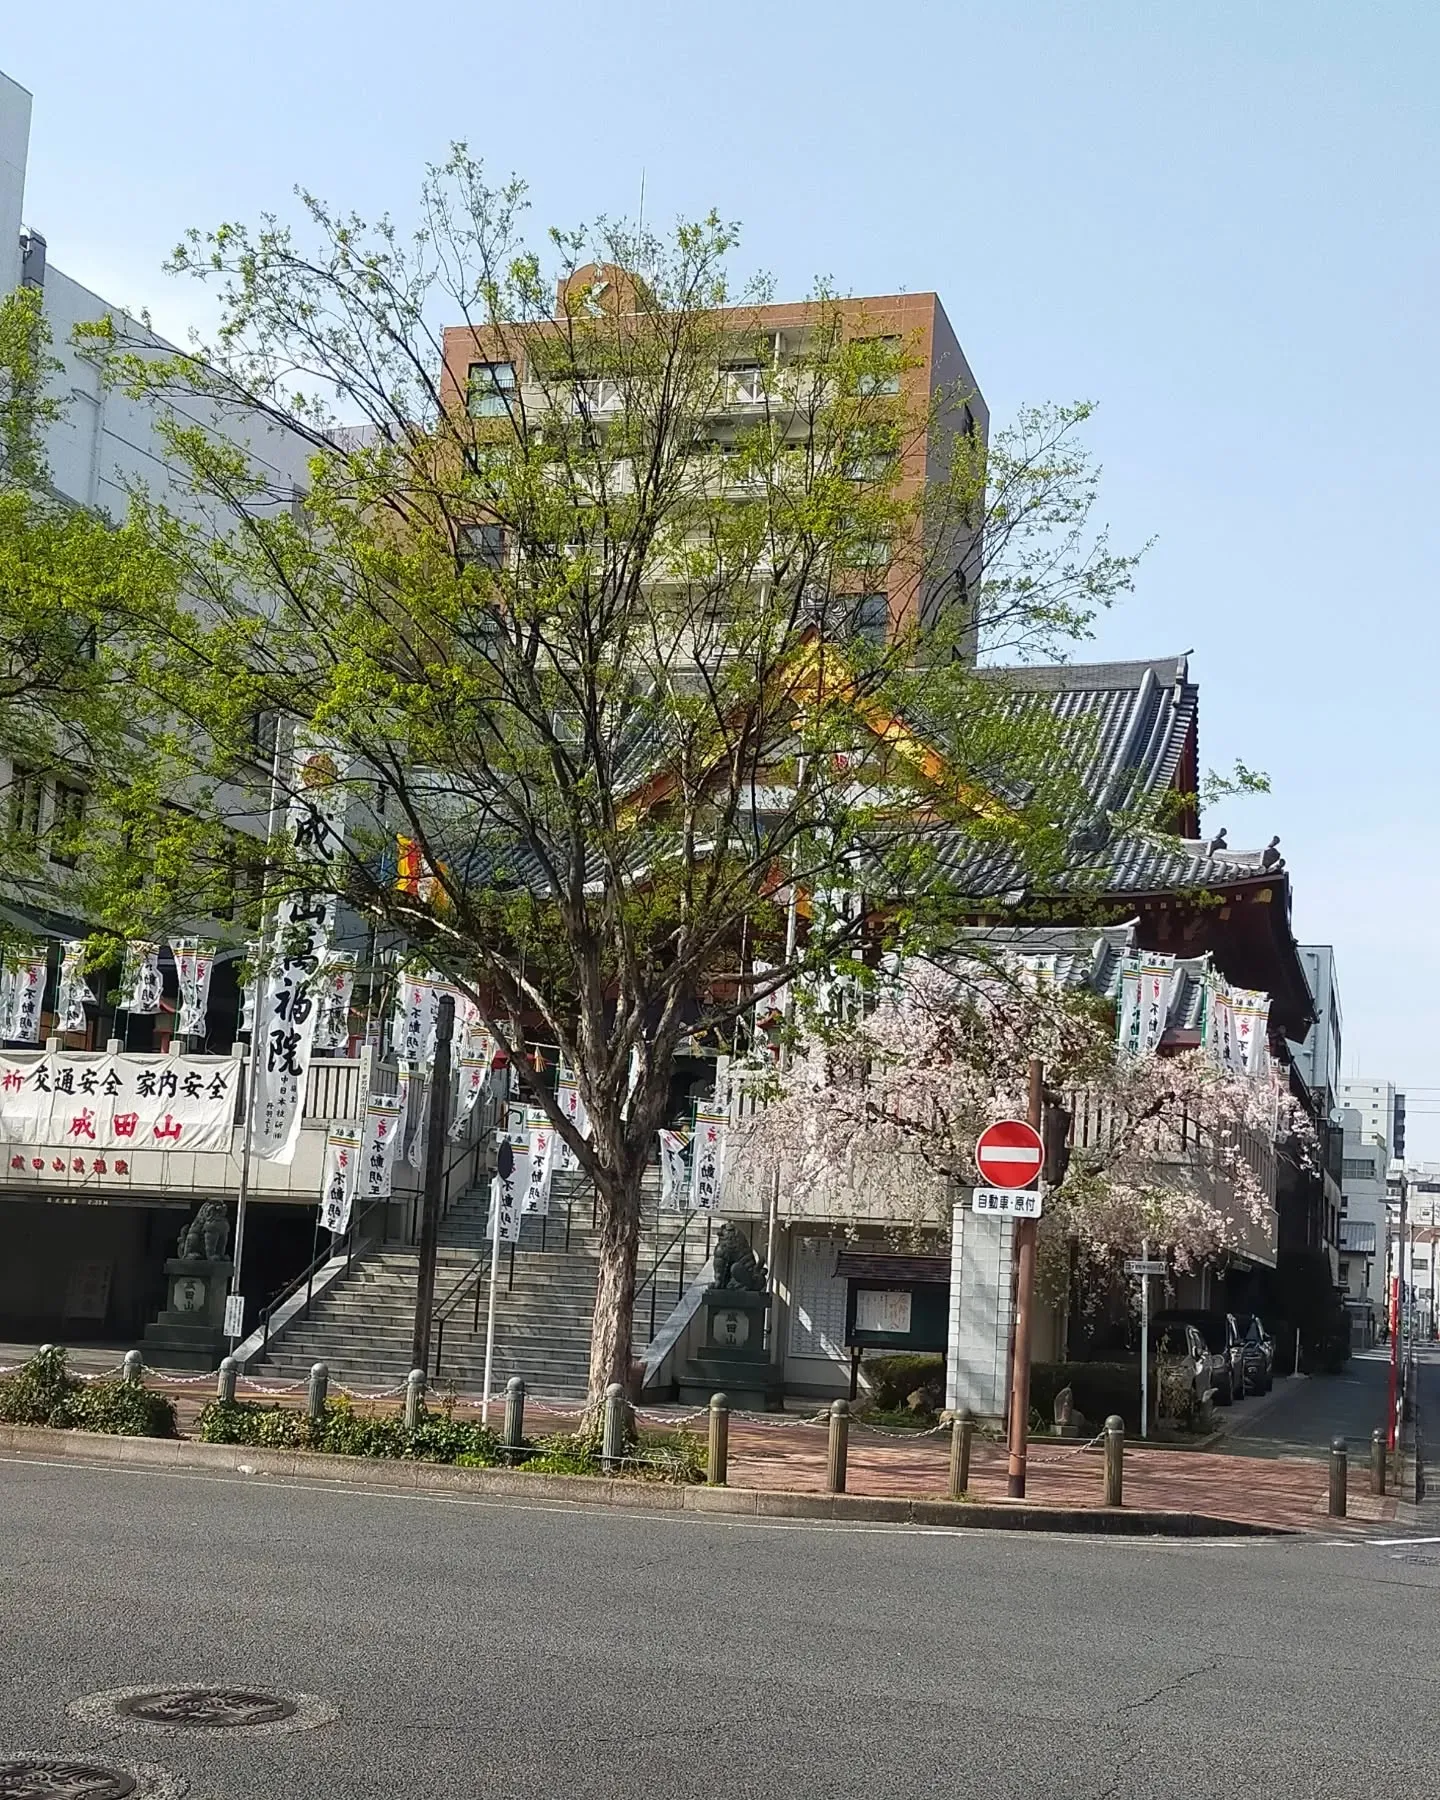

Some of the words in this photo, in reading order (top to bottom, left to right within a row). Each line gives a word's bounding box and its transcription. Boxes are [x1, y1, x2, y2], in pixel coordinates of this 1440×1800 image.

[2, 1069, 25, 1093] 祈
[33, 1065, 123, 1096] 交通安全
[136, 1071, 228, 1100] 家内安全
[67, 1107, 183, 1140] 成田山
[978, 1194, 1036, 1211] 自動車・原付
